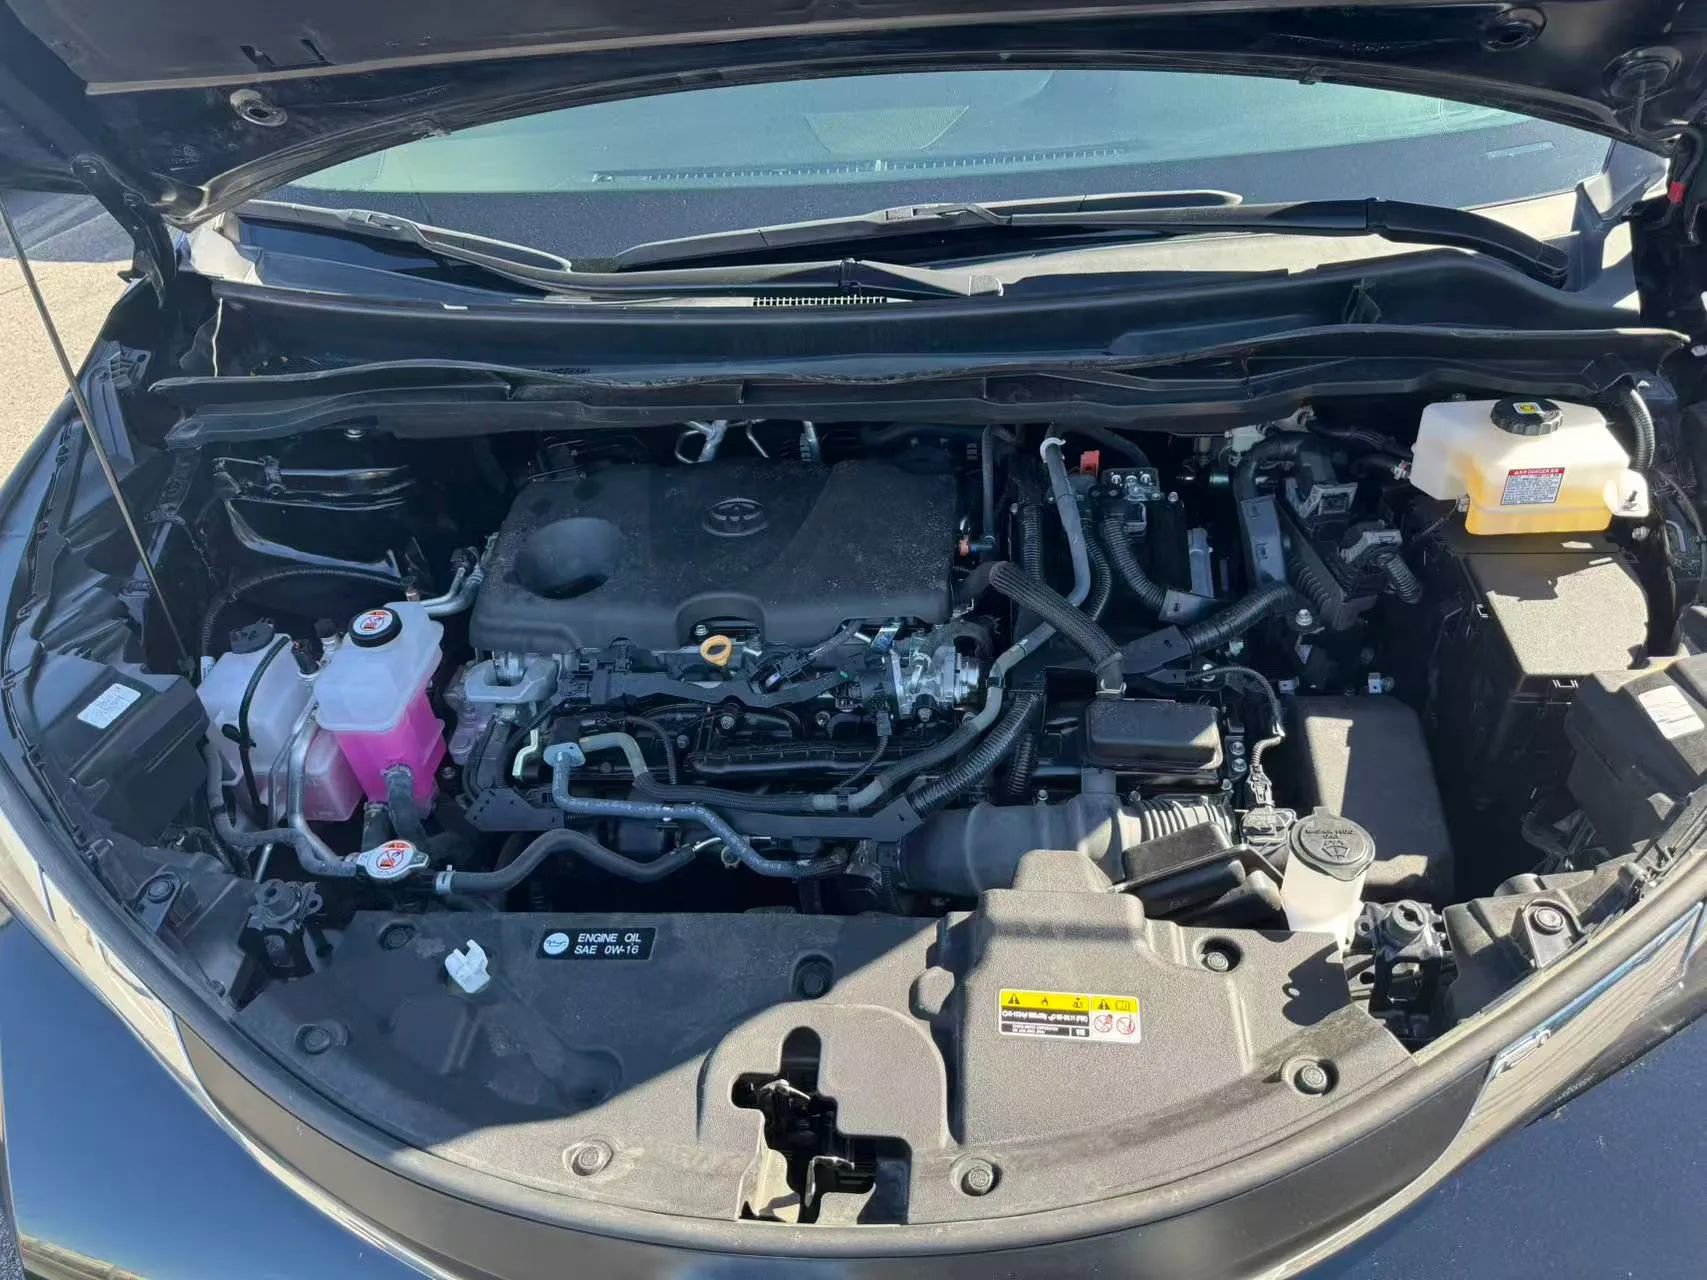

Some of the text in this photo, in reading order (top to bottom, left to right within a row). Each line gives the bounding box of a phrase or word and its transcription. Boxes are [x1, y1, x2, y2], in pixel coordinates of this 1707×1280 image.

[577, 932, 642, 943] ENGINE OIL
[574, 944, 639, 955] SAE 0W-16
